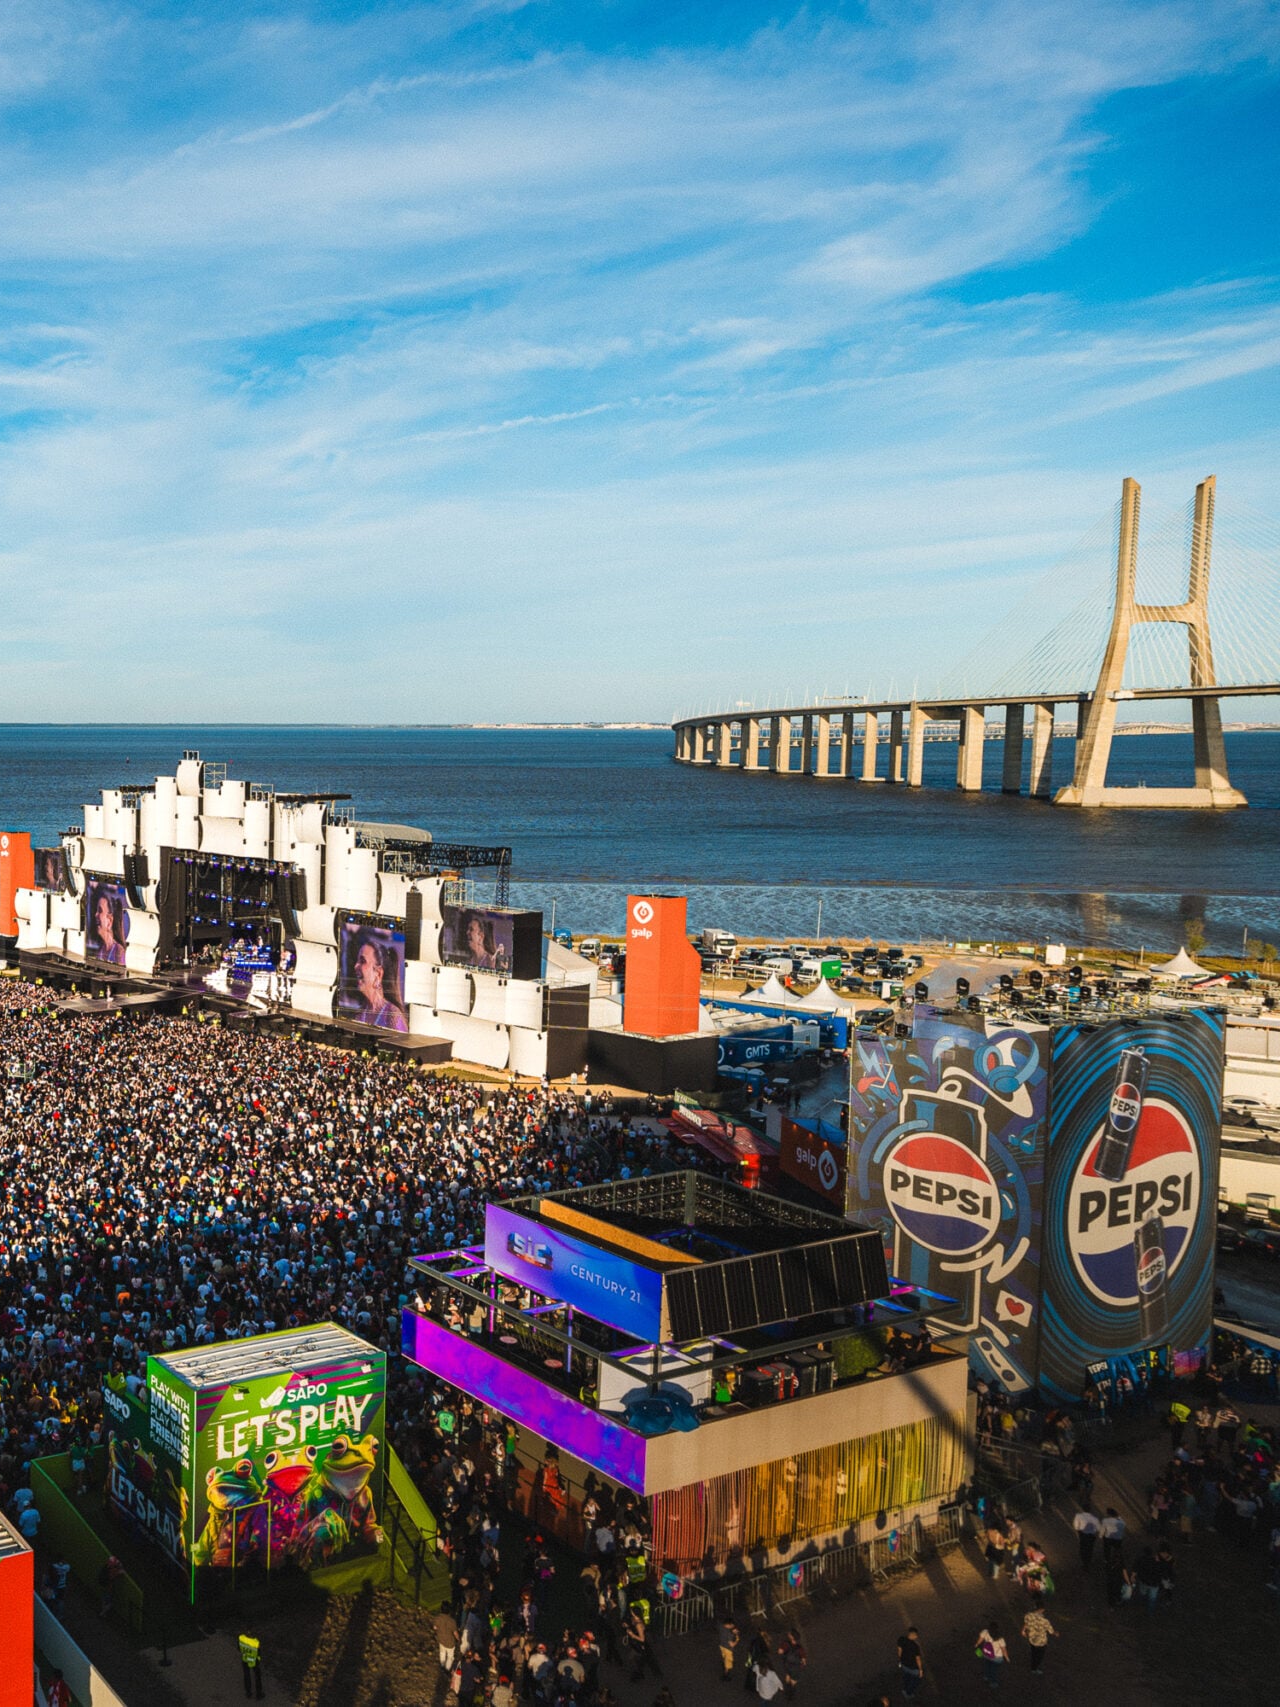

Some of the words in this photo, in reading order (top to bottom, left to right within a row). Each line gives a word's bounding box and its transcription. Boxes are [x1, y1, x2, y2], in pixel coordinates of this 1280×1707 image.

[631, 927, 652, 940] galp
[745, 1044, 770, 1059] GMTS
[1113, 1098, 1138, 1118] PEPSI
[796, 1147, 817, 1170] galp
[890, 1168, 992, 1220] PEPSI
[1078, 1171, 1192, 1233] PEPSI
[570, 1265, 627, 1297] CENTURY
[629, 1290, 641, 1302] 21
[1139, 1264, 1164, 1283] PEPSI
[104, 1388, 130, 1418] SAPO
[150, 1387, 190, 1431] MUSIC
[151, 1374, 169, 1396] PLAY
[171, 1389, 190, 1414] WITH
[287, 1383, 327, 1403] SAPO
[150, 1404, 170, 1426] PLAY
[171, 1422, 190, 1446] WITH
[300, 1393, 373, 1443] PLAY
[150, 1417, 189, 1459] FRIENDS
[147, 1498, 180, 1556] PLAY
